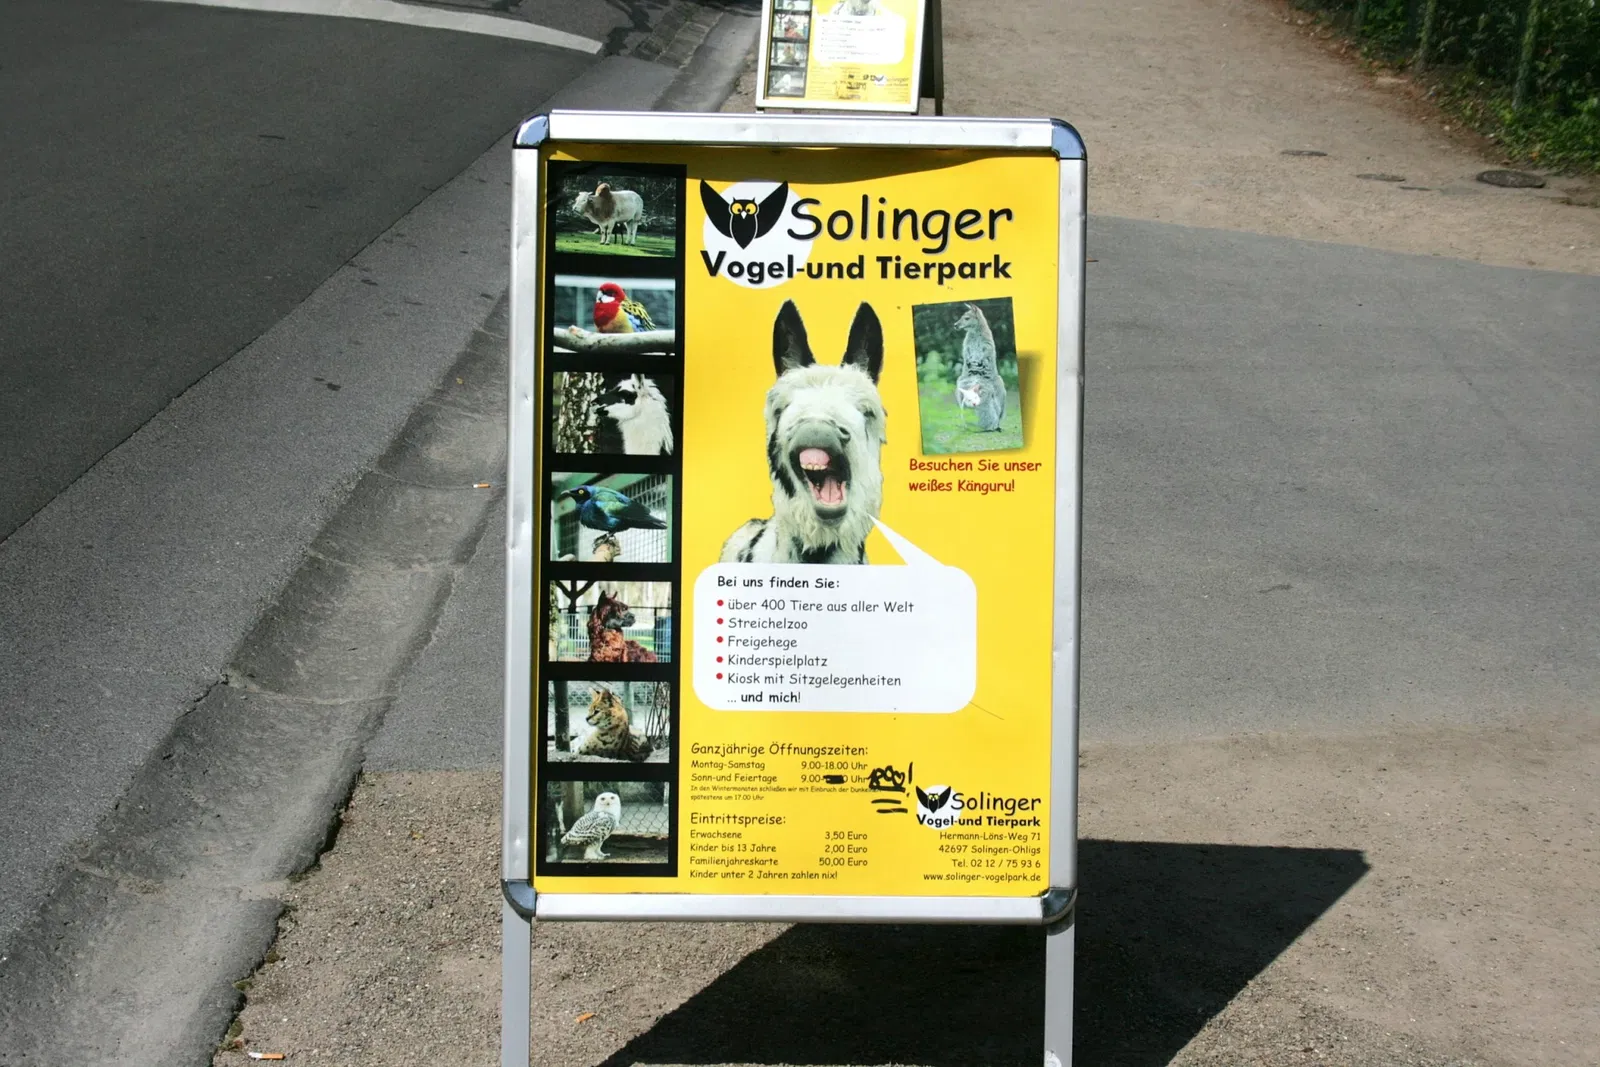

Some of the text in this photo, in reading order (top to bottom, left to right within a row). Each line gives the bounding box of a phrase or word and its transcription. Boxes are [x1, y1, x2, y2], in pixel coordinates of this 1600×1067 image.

[787, 194, 1013, 254] Solinger
[876, 254, 1012, 285] Tierpark
[909, 459, 1042, 471] Besuchen Sie unser
[909, 479, 1015, 495] weißes Känguru!
[717, 576, 840, 589] Bei uns finden Sie:
[728, 599, 914, 613] über 400 Tiere aus aller Welt
[728, 618, 808, 629] Streichelzoo
[727, 636, 797, 650] Freigehege
[727, 655, 827, 668] Kinderspielplatz
[727, 673, 901, 688] Kiosk mit Sitzgelegenheiten
[741, 692, 763, 702] und
[769, 692, 801, 703] mich!
[691, 742, 868, 758] Ganzjährige Öffnungszeiten:
[691, 760, 868, 771] Montag-Samstag 9.00-18.00 Uhr
[734, 774, 777, 784] Feiertage
[950, 792, 1041, 817] Solinger
[690, 812, 786, 827] Eintrittspreise:
[987, 816, 1041, 828] Tierpark
[690, 830, 868, 840] Erwachsene 3,50 Euro
[939, 832, 1041, 842] Hermann-Löns-Weg 71
[690, 843, 868, 854] Kinder bis 13 Jahre 2,00 Euro
[938, 845, 1041, 856] 42697 Solingen-Ohligs
[690, 857, 868, 868] Familienjahreskarte 50,00 Euro
[952, 859, 968, 868] Tel.
[971, 859, 983, 868] 02
[985, 859, 995, 868] 12
[690, 870, 718, 878] Kinder
[757, 871, 788, 879] Jahren
[791, 871, 819, 879] zahlen
[822, 871, 837, 879] nix!
[923, 872, 1041, 883] www.solinger-vogelpark.de
